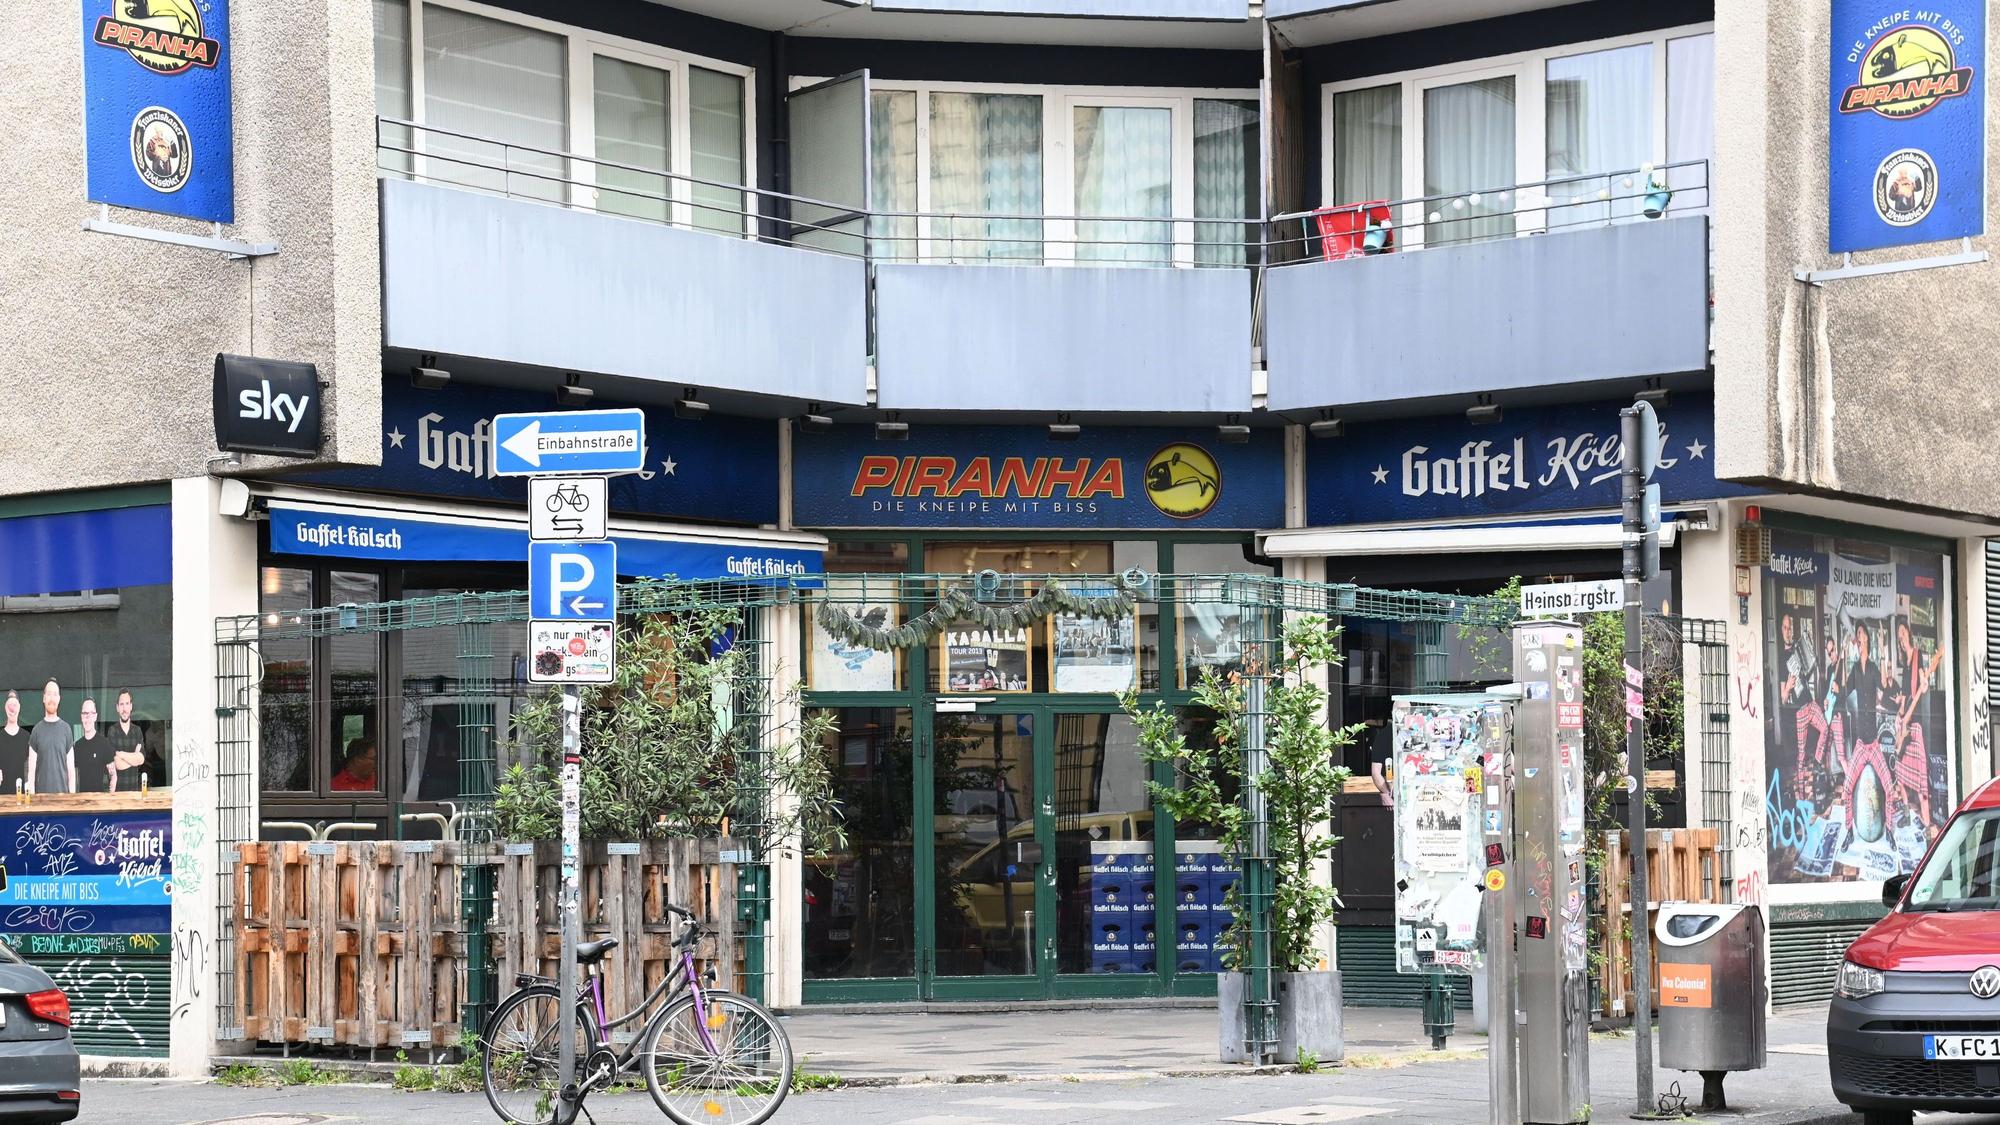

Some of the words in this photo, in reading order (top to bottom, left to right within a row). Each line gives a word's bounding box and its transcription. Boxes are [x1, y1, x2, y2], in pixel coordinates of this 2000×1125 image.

[102, 22, 208, 62] PIRANHA
[1848, 40, 1865, 63] DIE
[1865, 11, 1910, 38] KNEIPE
[1915, 10, 1941, 24] MIT
[1941, 20, 1965, 46] BISS
[1848, 73, 1959, 108] PIRANHA
[239, 379, 309, 433] sky
[537, 436, 634, 450] Einbahnstraße
[851, 455, 1125, 499] PIRANHA
[1401, 437, 1530, 498] Gaffel
[872, 501, 905, 512] DIE
[919, 501, 991, 512] KNEIPE
[1004, 501, 1039, 512] MIT
[1054, 501, 1098, 513] BISS
[550, 553, 595, 616] P
[1833, 567, 1843, 583] SU
[1844, 569, 1862, 587] LANG
[1863, 572, 1875, 588] DIE
[1875, 572, 1892, 588] WELT
[554, 631, 569, 640] nur
[574, 629, 590, 640] mit
[951, 647, 967, 655] TOUR
[118, 829, 166, 858] Gaffel
[115, 858, 166, 888] Kölsch
[14, 882, 27, 900] DIE
[30, 882, 59, 900] KNEIPE
[62, 882, 78, 900] MIT
[79, 882, 99, 900] BISS
[1936, 1038, 1948, 1056] K
